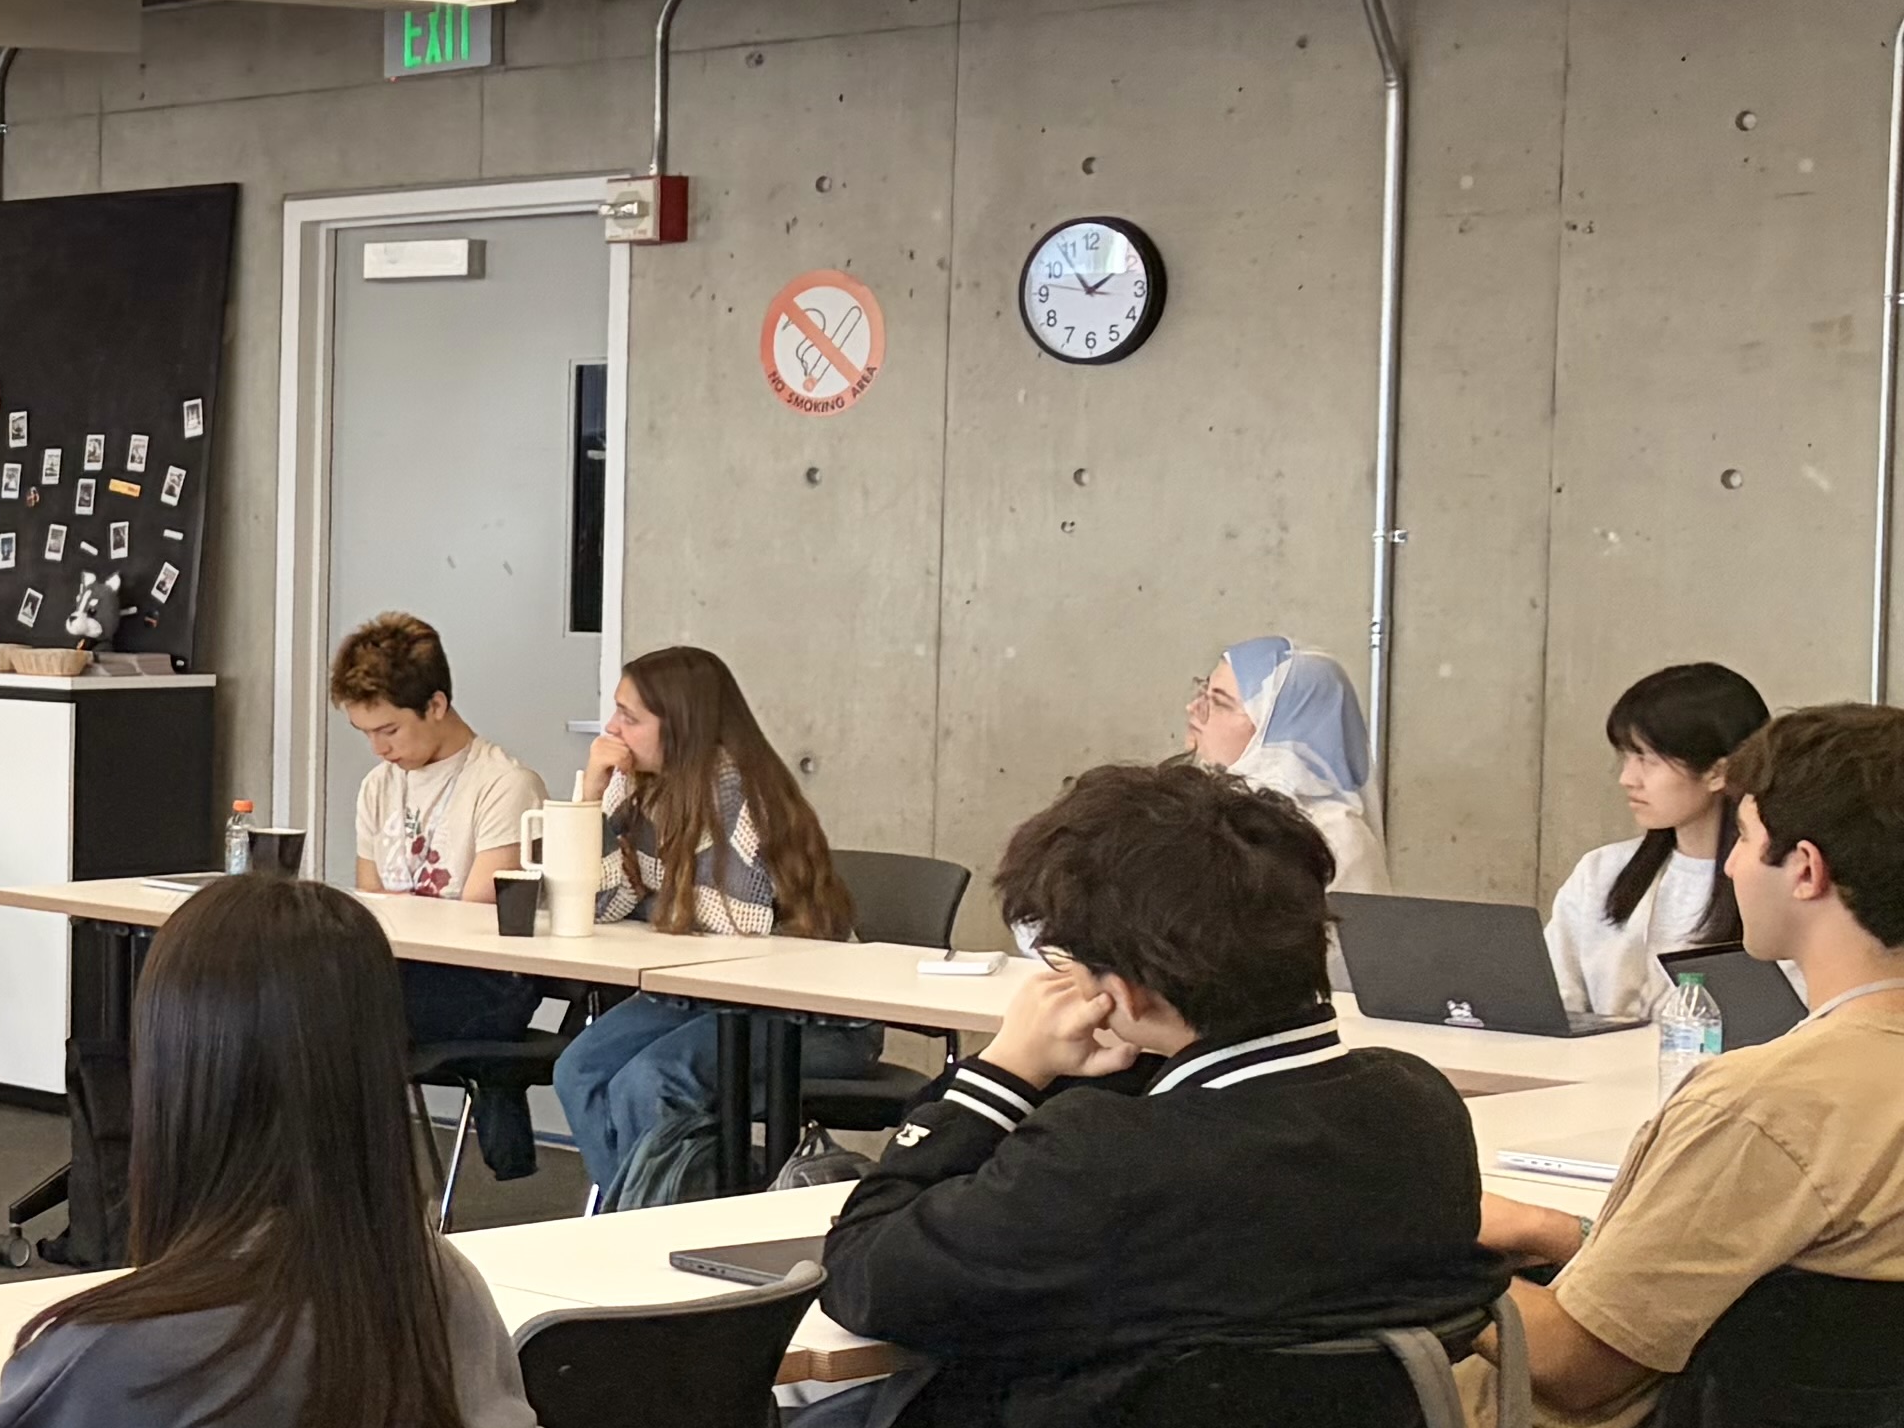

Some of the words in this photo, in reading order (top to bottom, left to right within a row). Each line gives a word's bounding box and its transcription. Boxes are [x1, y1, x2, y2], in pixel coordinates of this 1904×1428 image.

[403, 4, 470, 68] EXIT
[1061, 241, 1076, 258] 11
[1083, 232, 1100, 250] 12
[1046, 261, 1063, 279] 10
[1126, 255, 1138, 272] 2
[1038, 284, 1049, 303] 9
[1133, 280, 1146, 298] 3
[1046, 309, 1057, 327] 8
[1125, 305, 1137, 322] 4
[1064, 326, 1075, 344] 7
[1085, 332, 1097, 349] 6
[1109, 324, 1120, 342] 5
[768, 371, 785, 393] NO
[786, 393, 845, 412] SMOKING
[851, 365, 877, 399] AREA
